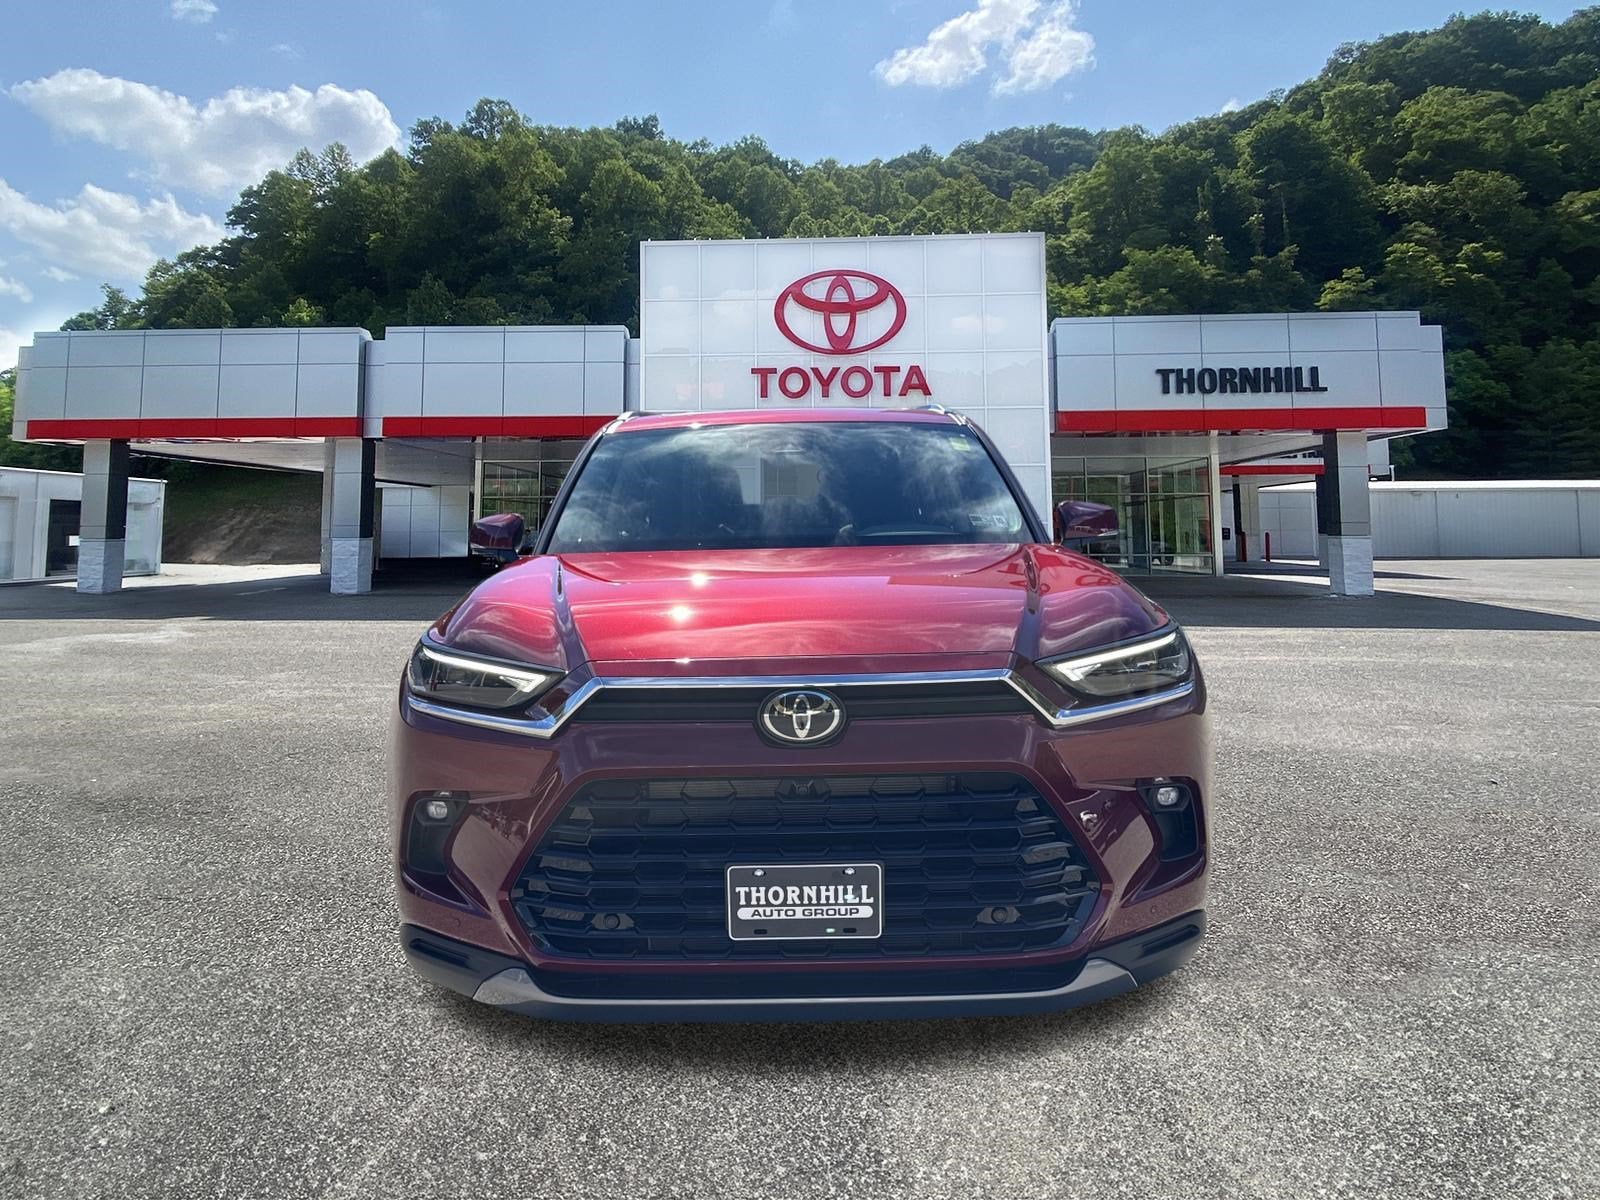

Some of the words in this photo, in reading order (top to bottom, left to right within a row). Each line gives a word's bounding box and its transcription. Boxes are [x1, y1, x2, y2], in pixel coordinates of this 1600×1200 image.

[750, 365, 932, 399] TOYOTA
[1155, 366, 1328, 394] THORNHILL
[735, 885, 874, 905] THORNHILL
[751, 908, 796, 918] AUTO
[802, 907, 860, 917] GROUP
